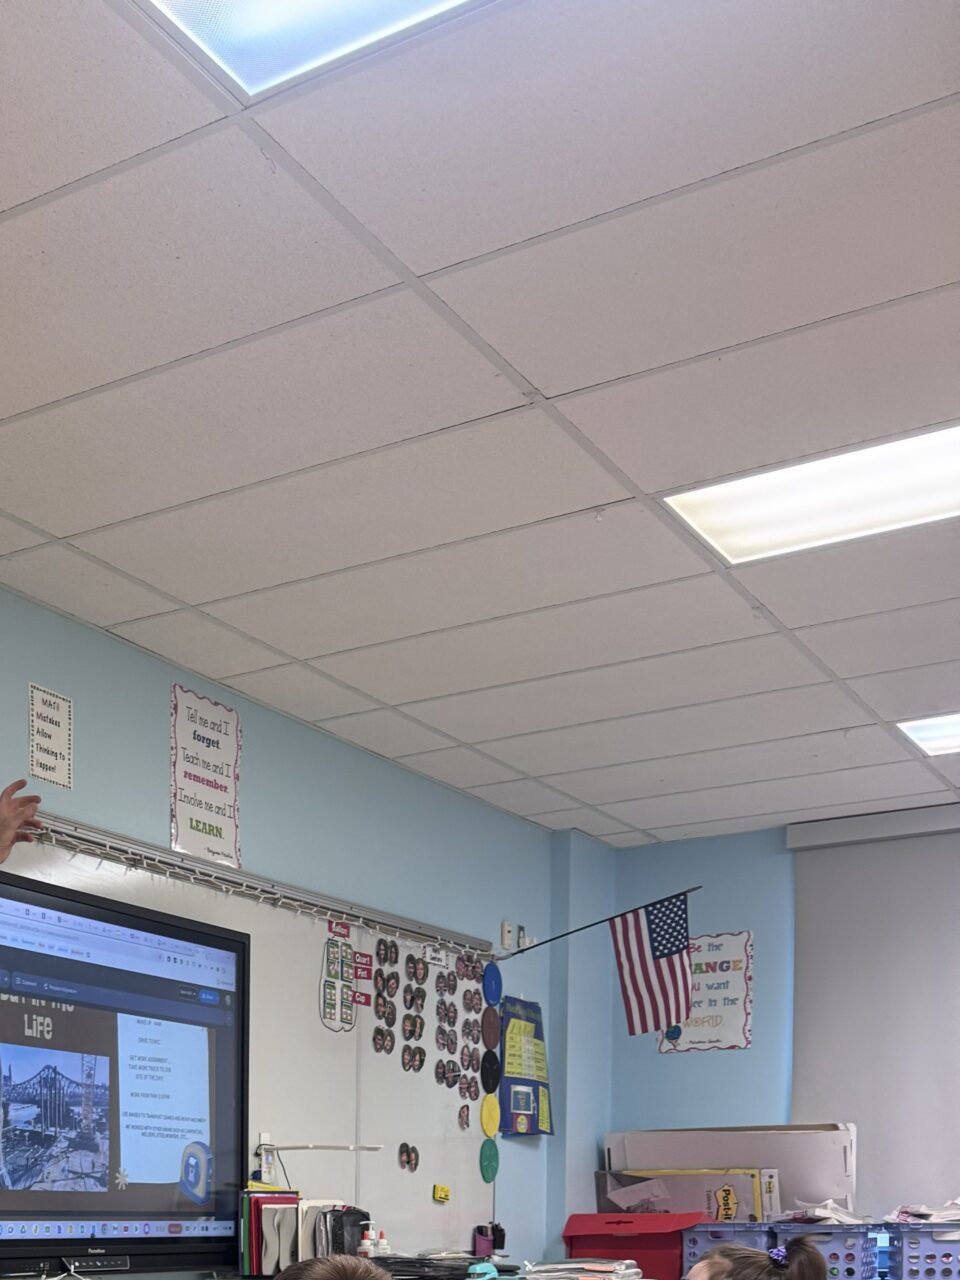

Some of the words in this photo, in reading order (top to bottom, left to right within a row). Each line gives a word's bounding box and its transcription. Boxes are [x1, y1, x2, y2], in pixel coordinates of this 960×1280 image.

[708, 943, 723, 952] the
[706, 981, 730, 990] want
[708, 998, 717, 1007] in
[723, 997, 739, 1006] the
[722, 1188, 732, 1221] Post-it
